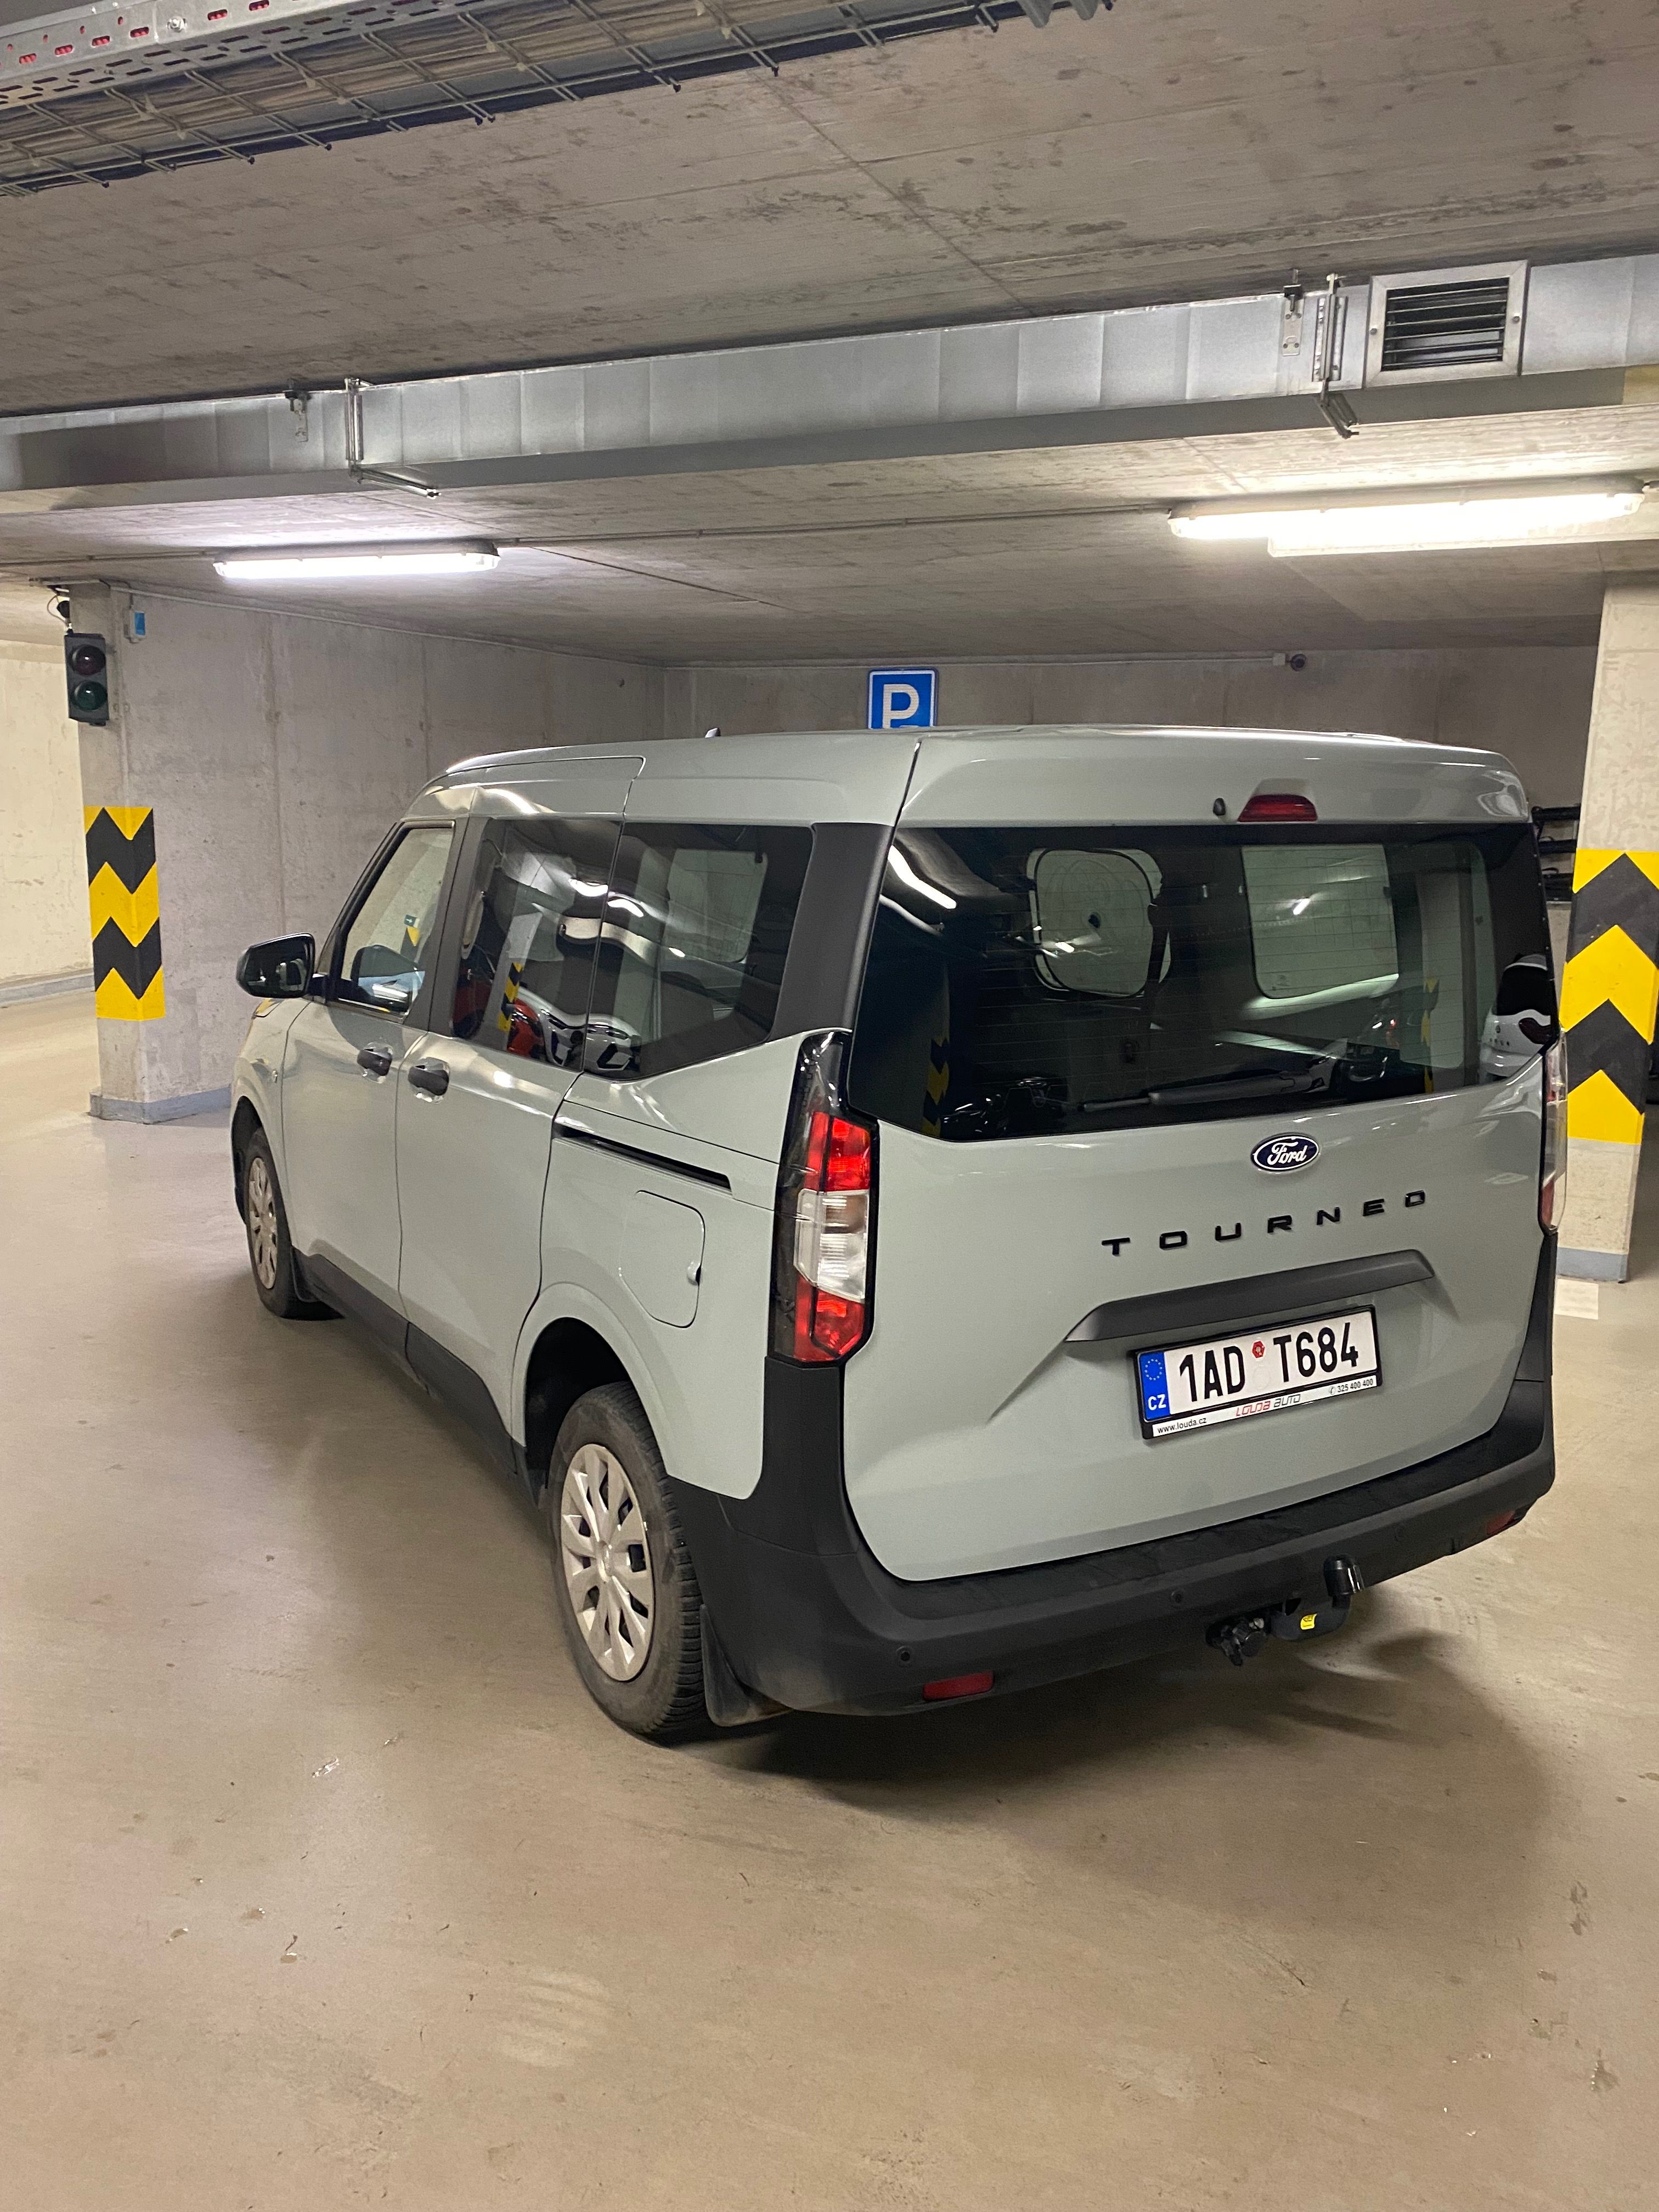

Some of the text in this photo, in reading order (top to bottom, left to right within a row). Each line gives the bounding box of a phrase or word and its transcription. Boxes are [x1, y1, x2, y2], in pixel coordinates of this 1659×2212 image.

[882, 684, 919, 729] P
[1267, 1142, 1308, 1165] Ford
[1101, 1190, 1425, 1256] TOURNEO
[1180, 1322, 1358, 1402] 1AD T684
[1338, 1378, 1374, 1392] 325 400 400
[1148, 1394, 1166, 1410] CZ
[1157, 1417, 1207, 1434] www.louda.cz
